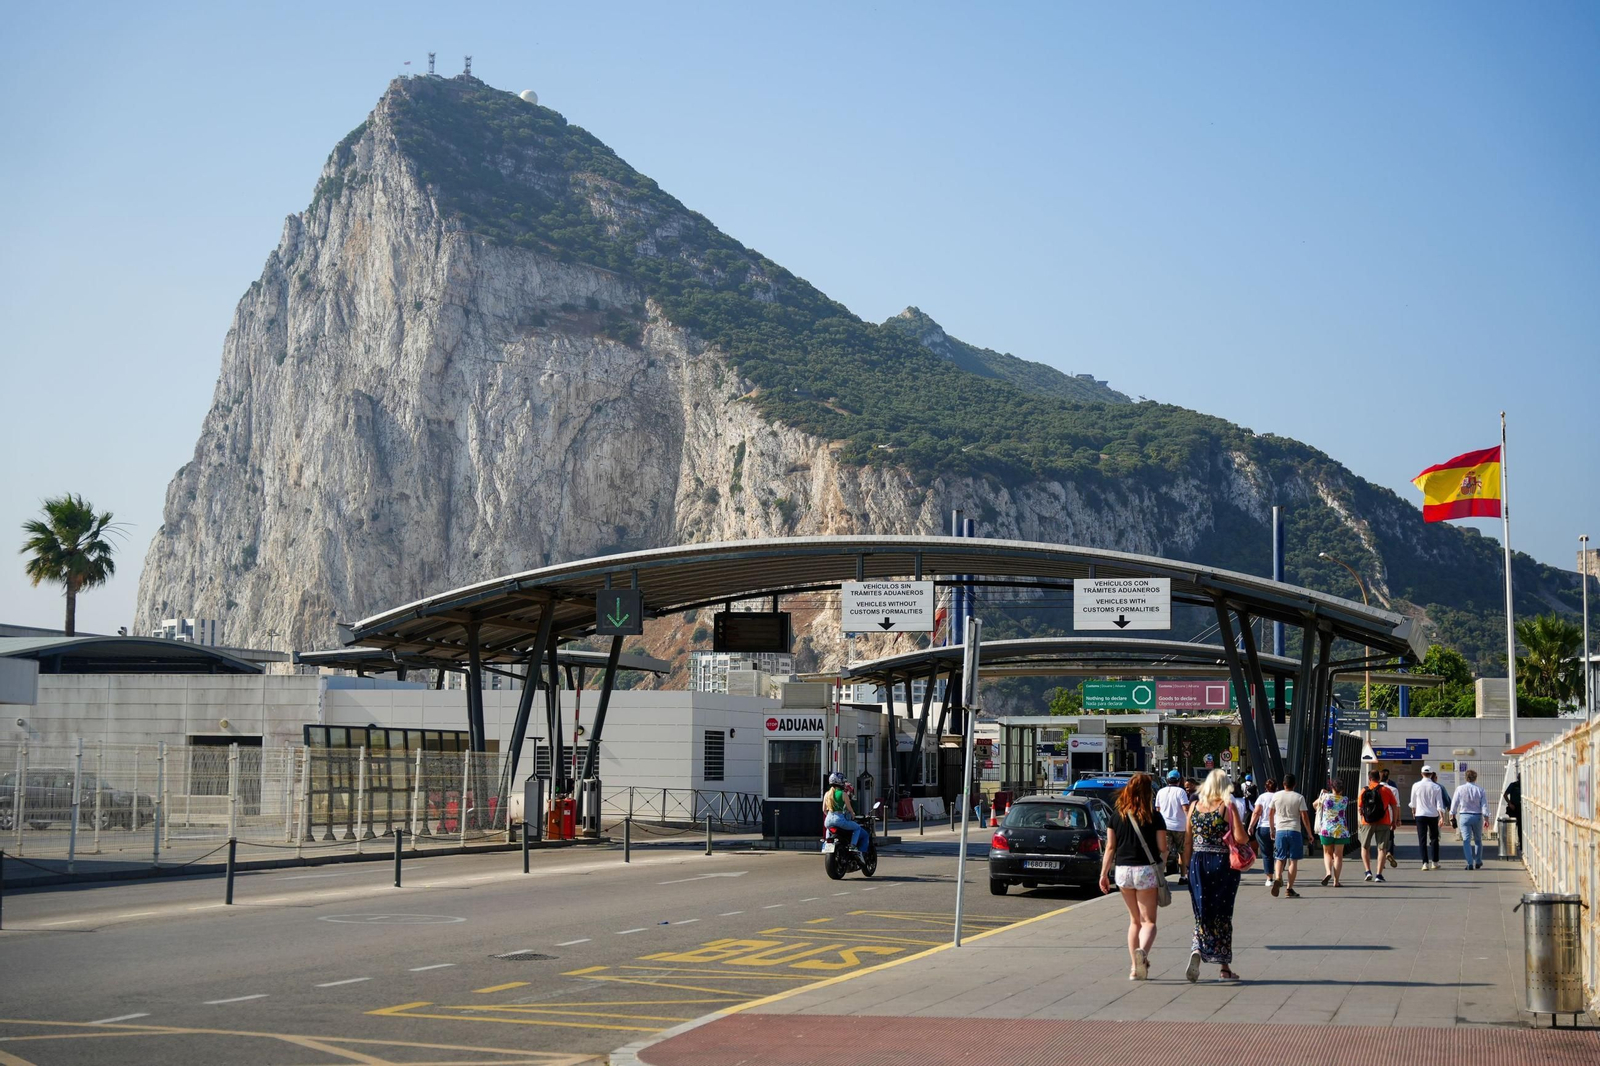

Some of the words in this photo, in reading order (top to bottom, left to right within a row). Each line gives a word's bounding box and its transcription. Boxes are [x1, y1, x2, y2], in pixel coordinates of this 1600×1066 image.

[779, 718, 825, 731] ADUANA
[1222, 752, 1230, 760] 10
[653, 939, 907, 970] BUS
